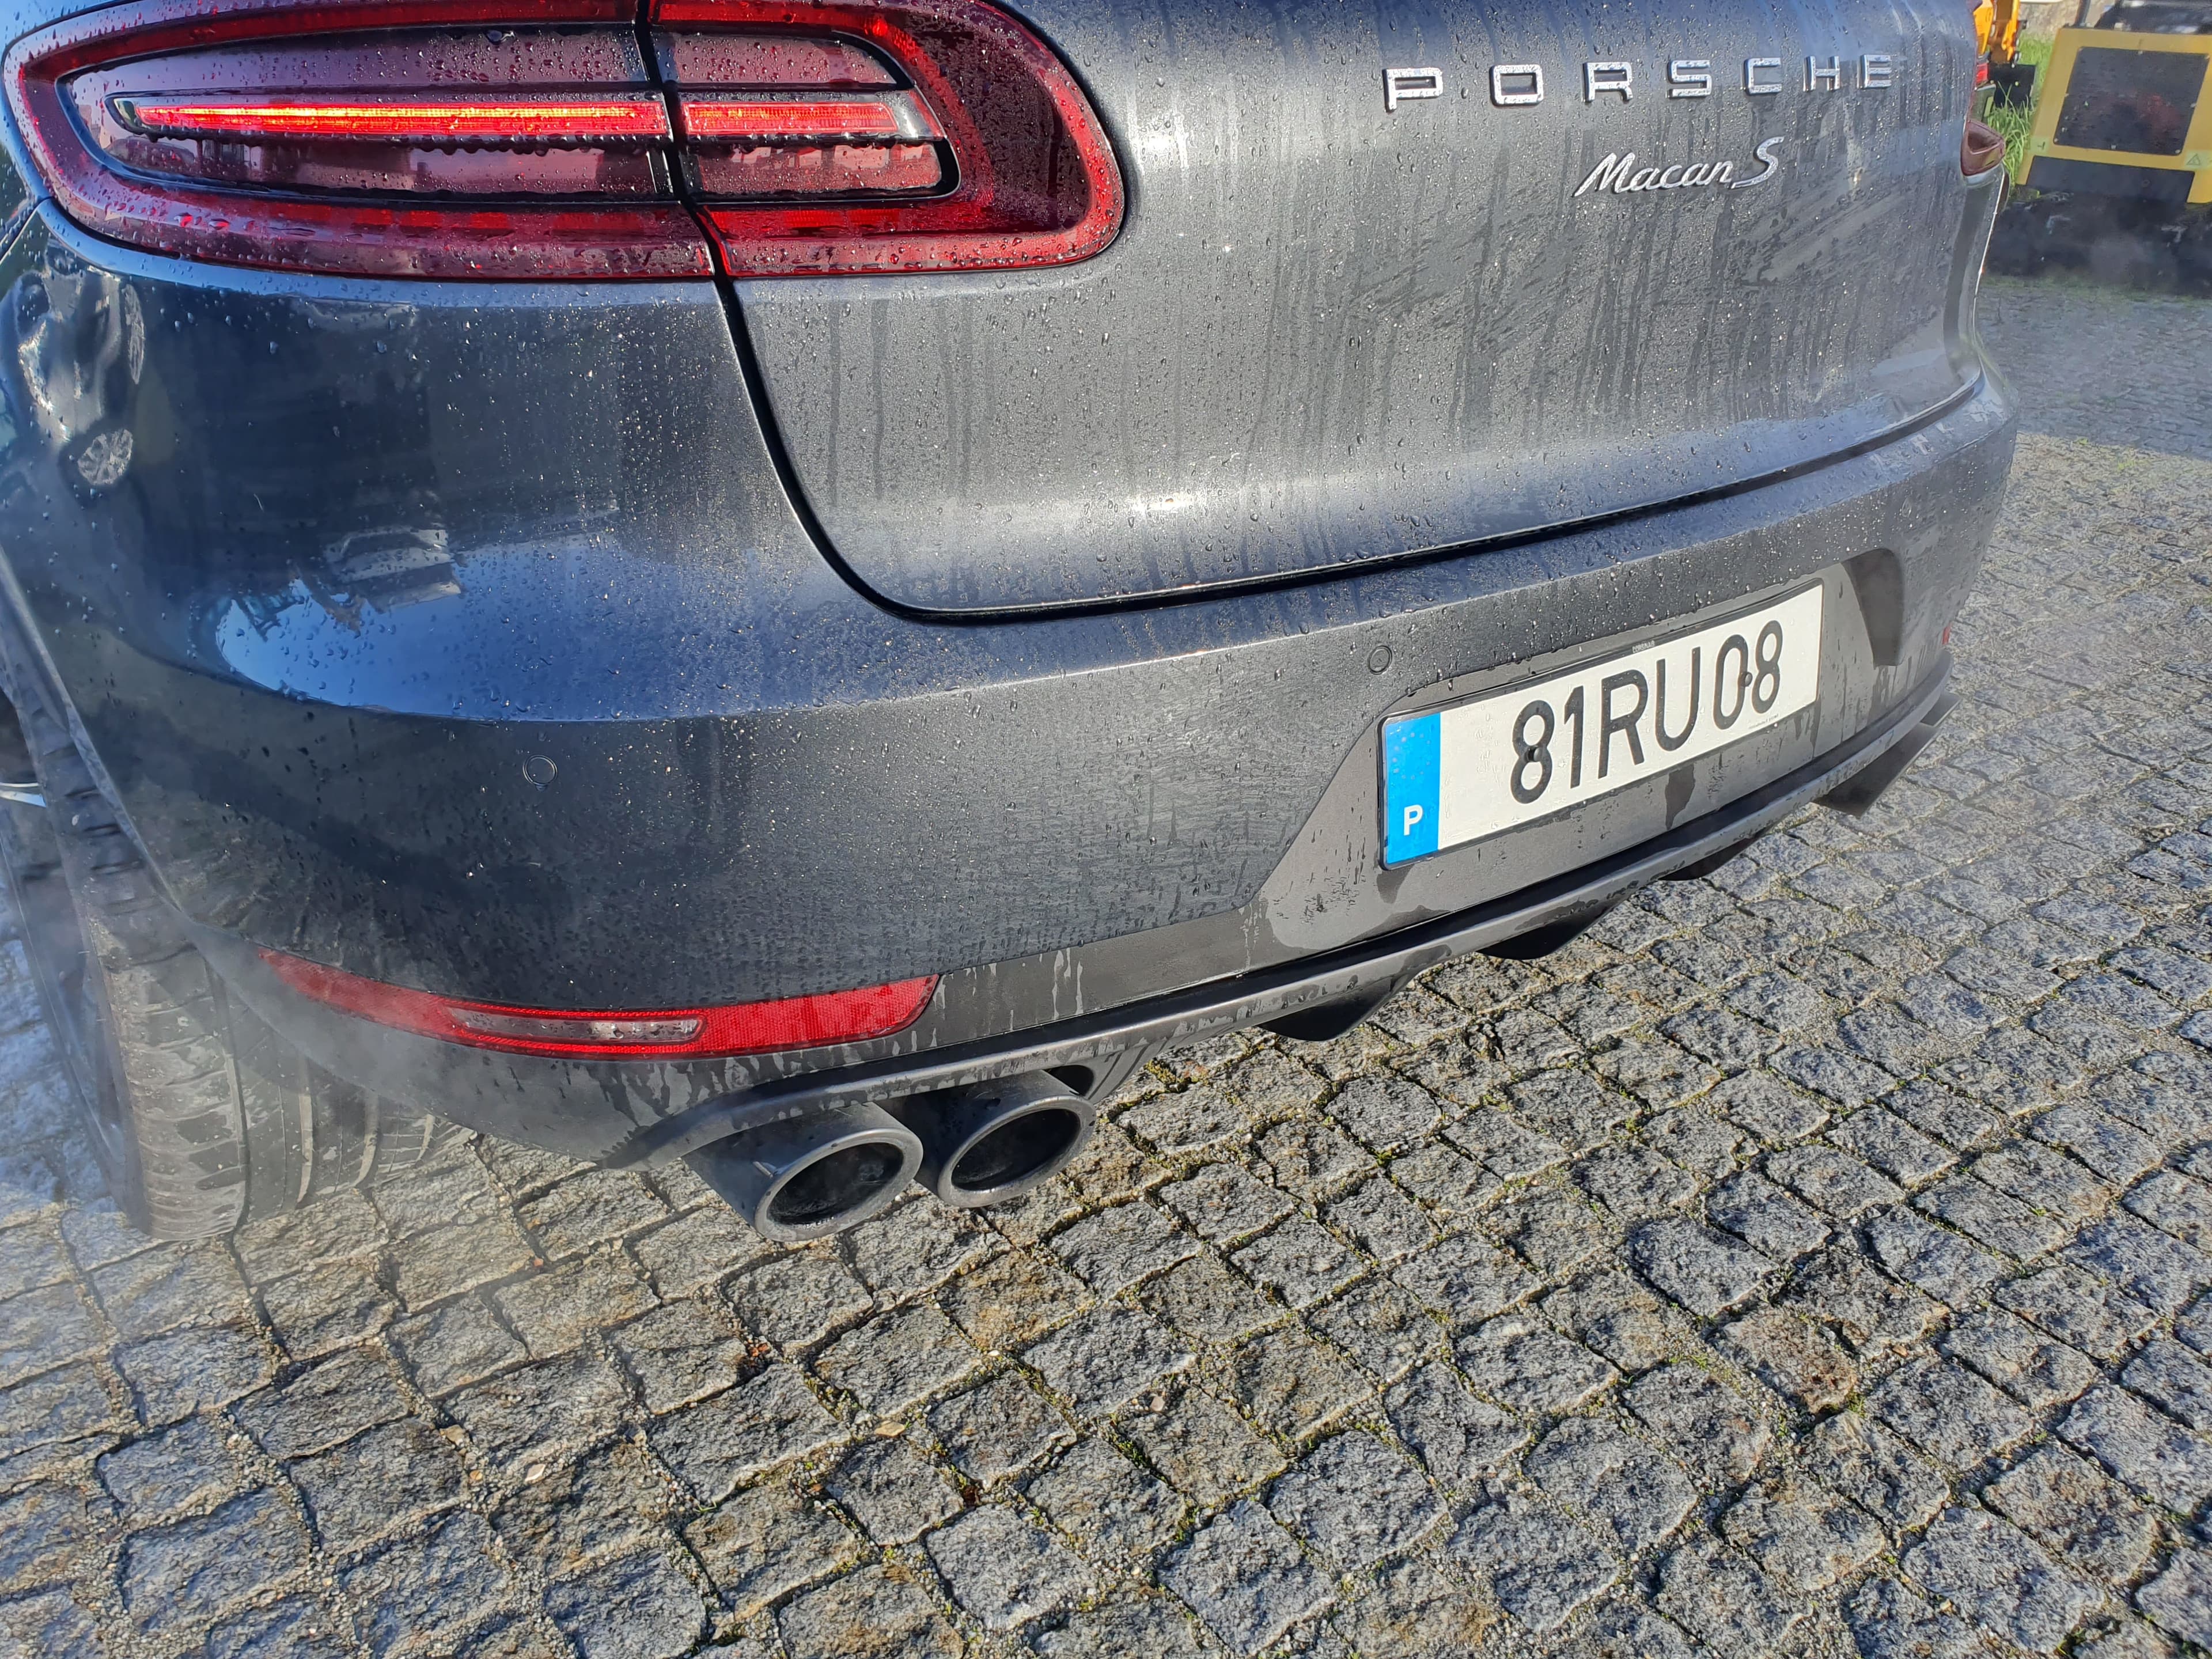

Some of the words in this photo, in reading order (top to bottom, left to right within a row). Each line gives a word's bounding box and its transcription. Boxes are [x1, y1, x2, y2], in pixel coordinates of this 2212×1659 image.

[1383, 54, 1893, 112] PORSCHE
[1572, 152, 1733, 198] Macan
[1731, 136, 1785, 189] S
[1403, 804, 1423, 836] P
